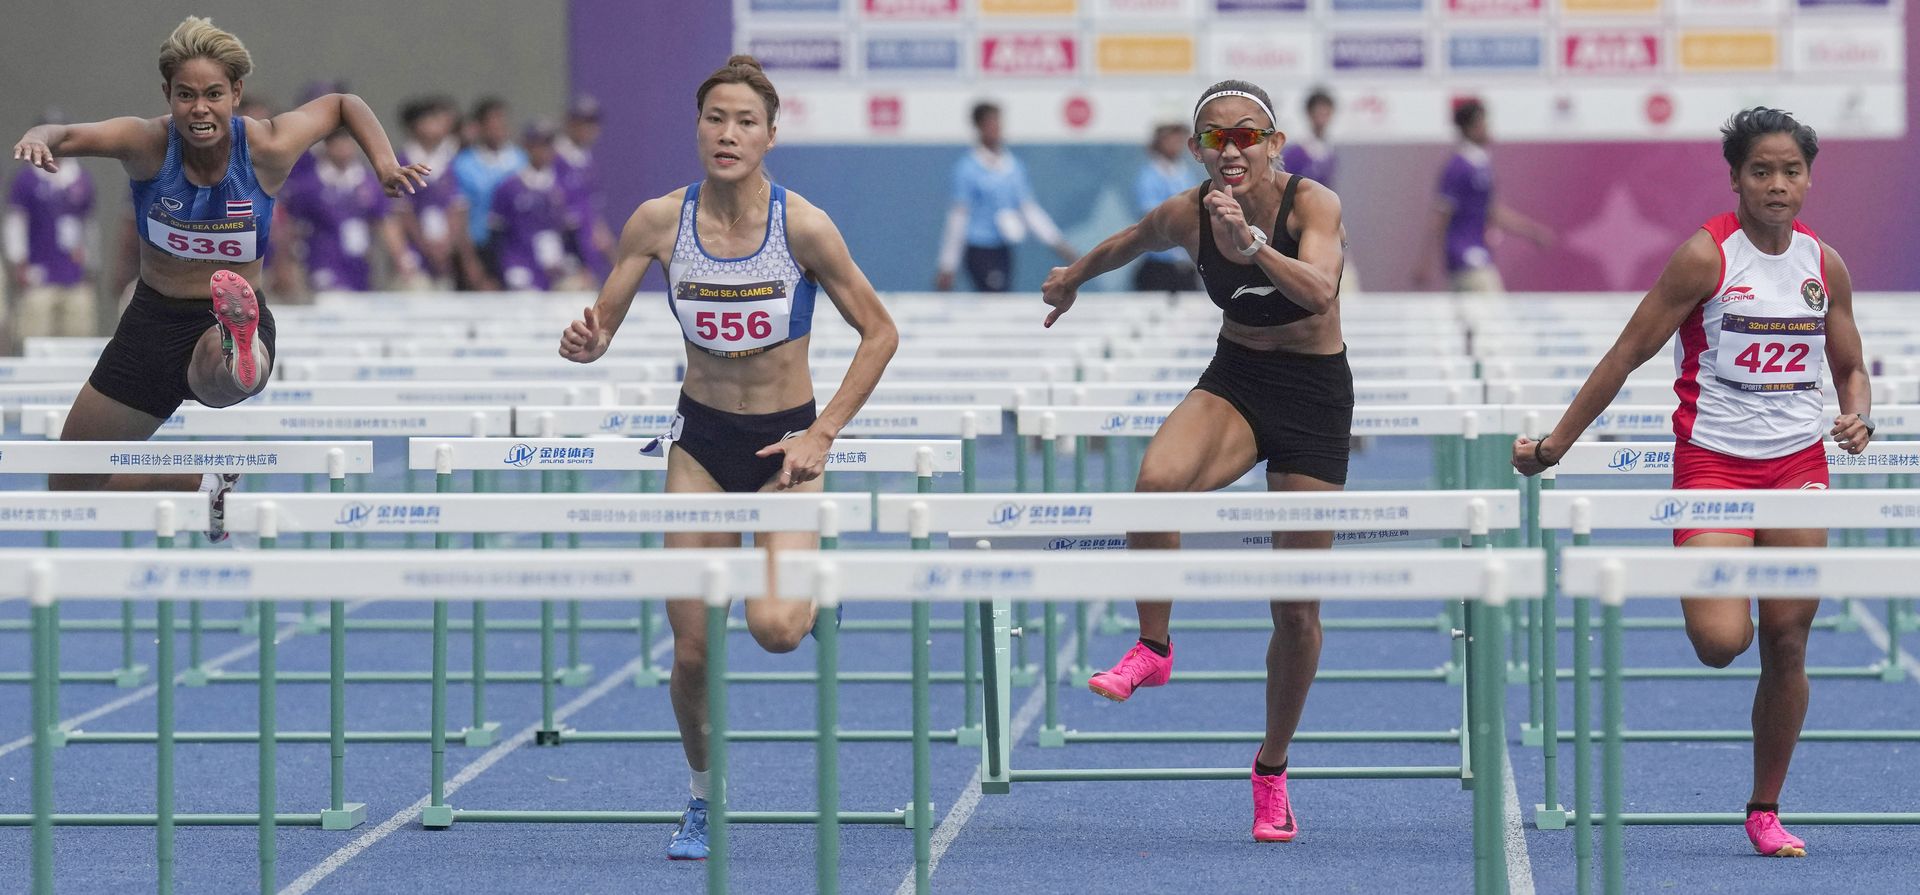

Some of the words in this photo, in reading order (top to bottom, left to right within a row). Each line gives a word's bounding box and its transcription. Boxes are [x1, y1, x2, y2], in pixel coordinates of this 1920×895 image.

[192, 222, 210, 231] SEA
[212, 221, 244, 231] GAMES
[167, 232, 242, 257] 536
[700, 288, 719, 297] 32nd
[721, 289, 738, 298] SEA
[740, 287, 773, 298] GAMES
[696, 310, 772, 341] 556
[1748, 321, 1768, 330] 32nd
[1770, 322, 1786, 330] SEA
[1788, 322, 1816, 331] GAMES
[1734, 342, 1810, 373] 422
[539, 447, 595, 458] 金陵体育
[1643, 451, 1674, 463] 金陵
[110, 453, 278, 467] 中国田径协会田径器材类官方供应商
